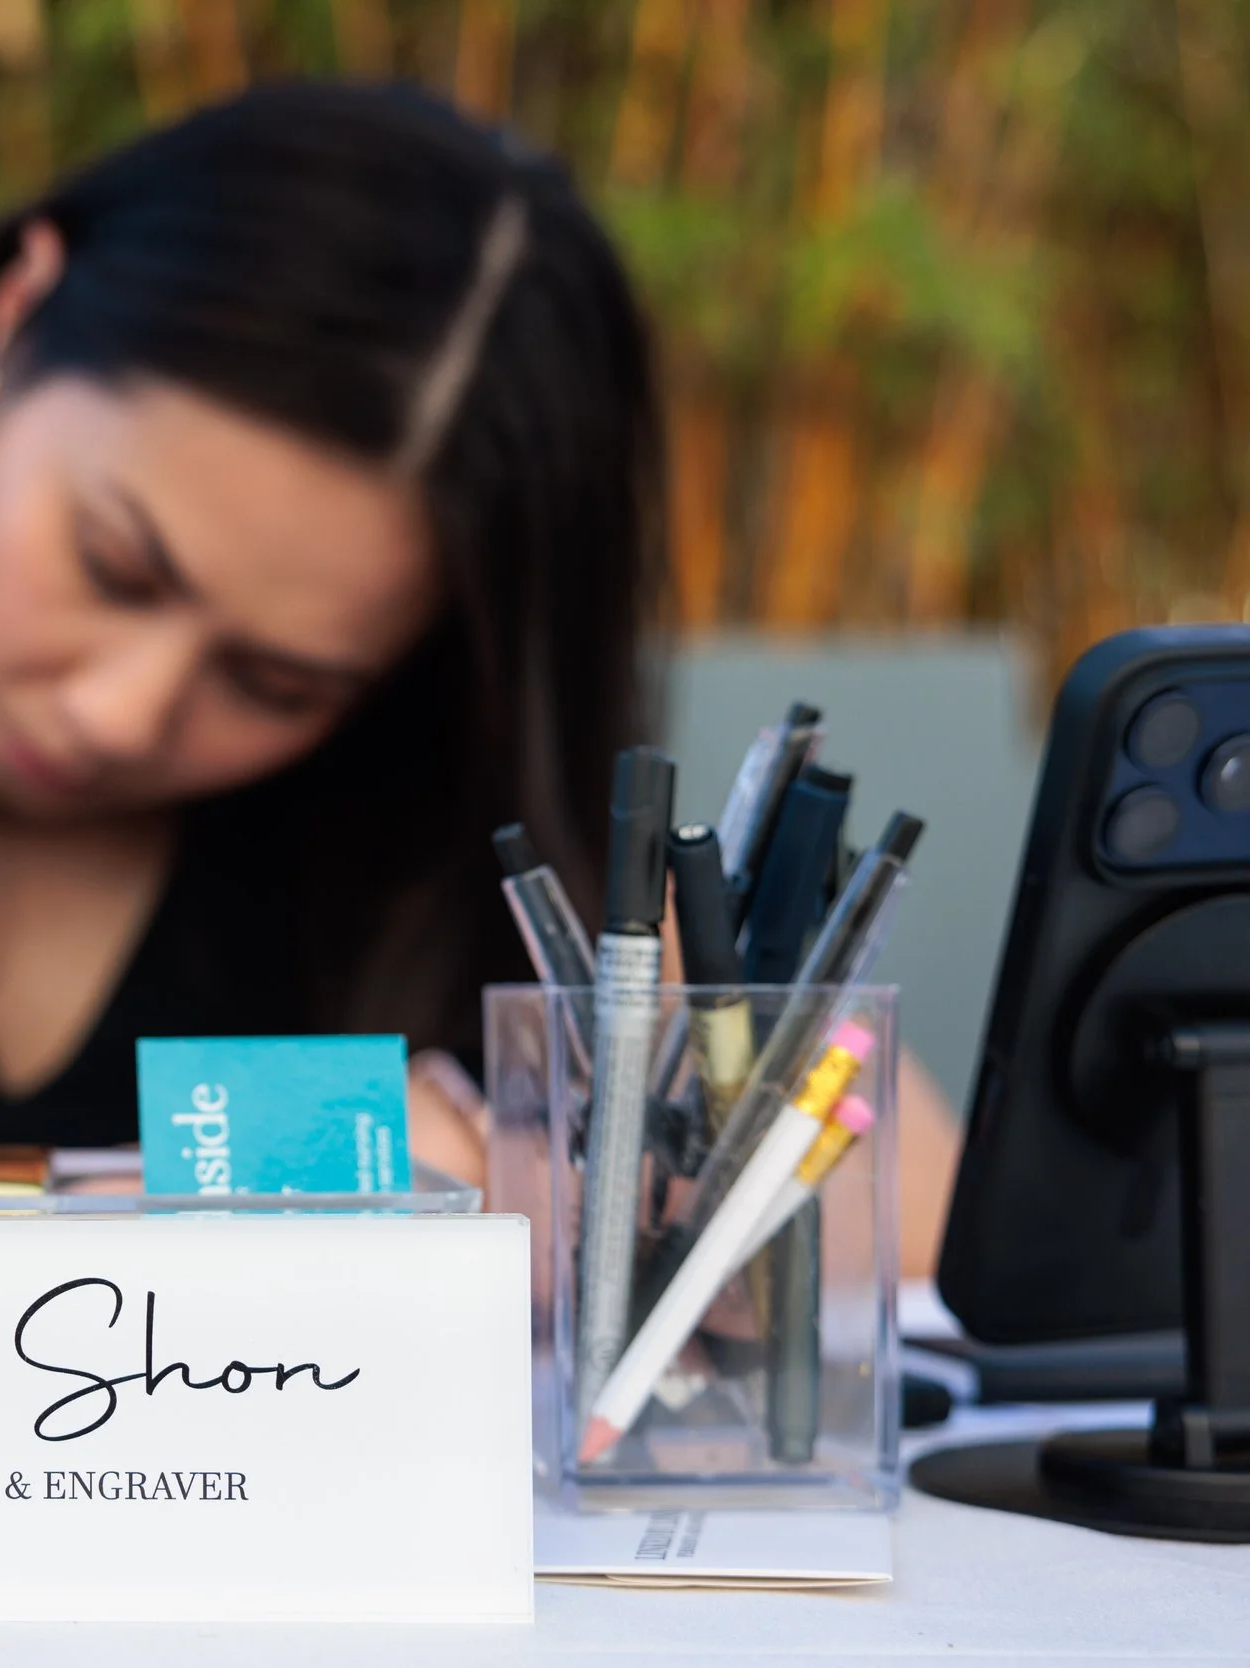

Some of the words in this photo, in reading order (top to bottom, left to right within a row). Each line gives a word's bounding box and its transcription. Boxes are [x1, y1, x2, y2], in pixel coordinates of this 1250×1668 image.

[14, 1277, 361, 1442] Shon
[4, 1470, 33, 1501] &
[43, 1470, 249, 1501] ENGRAVER
